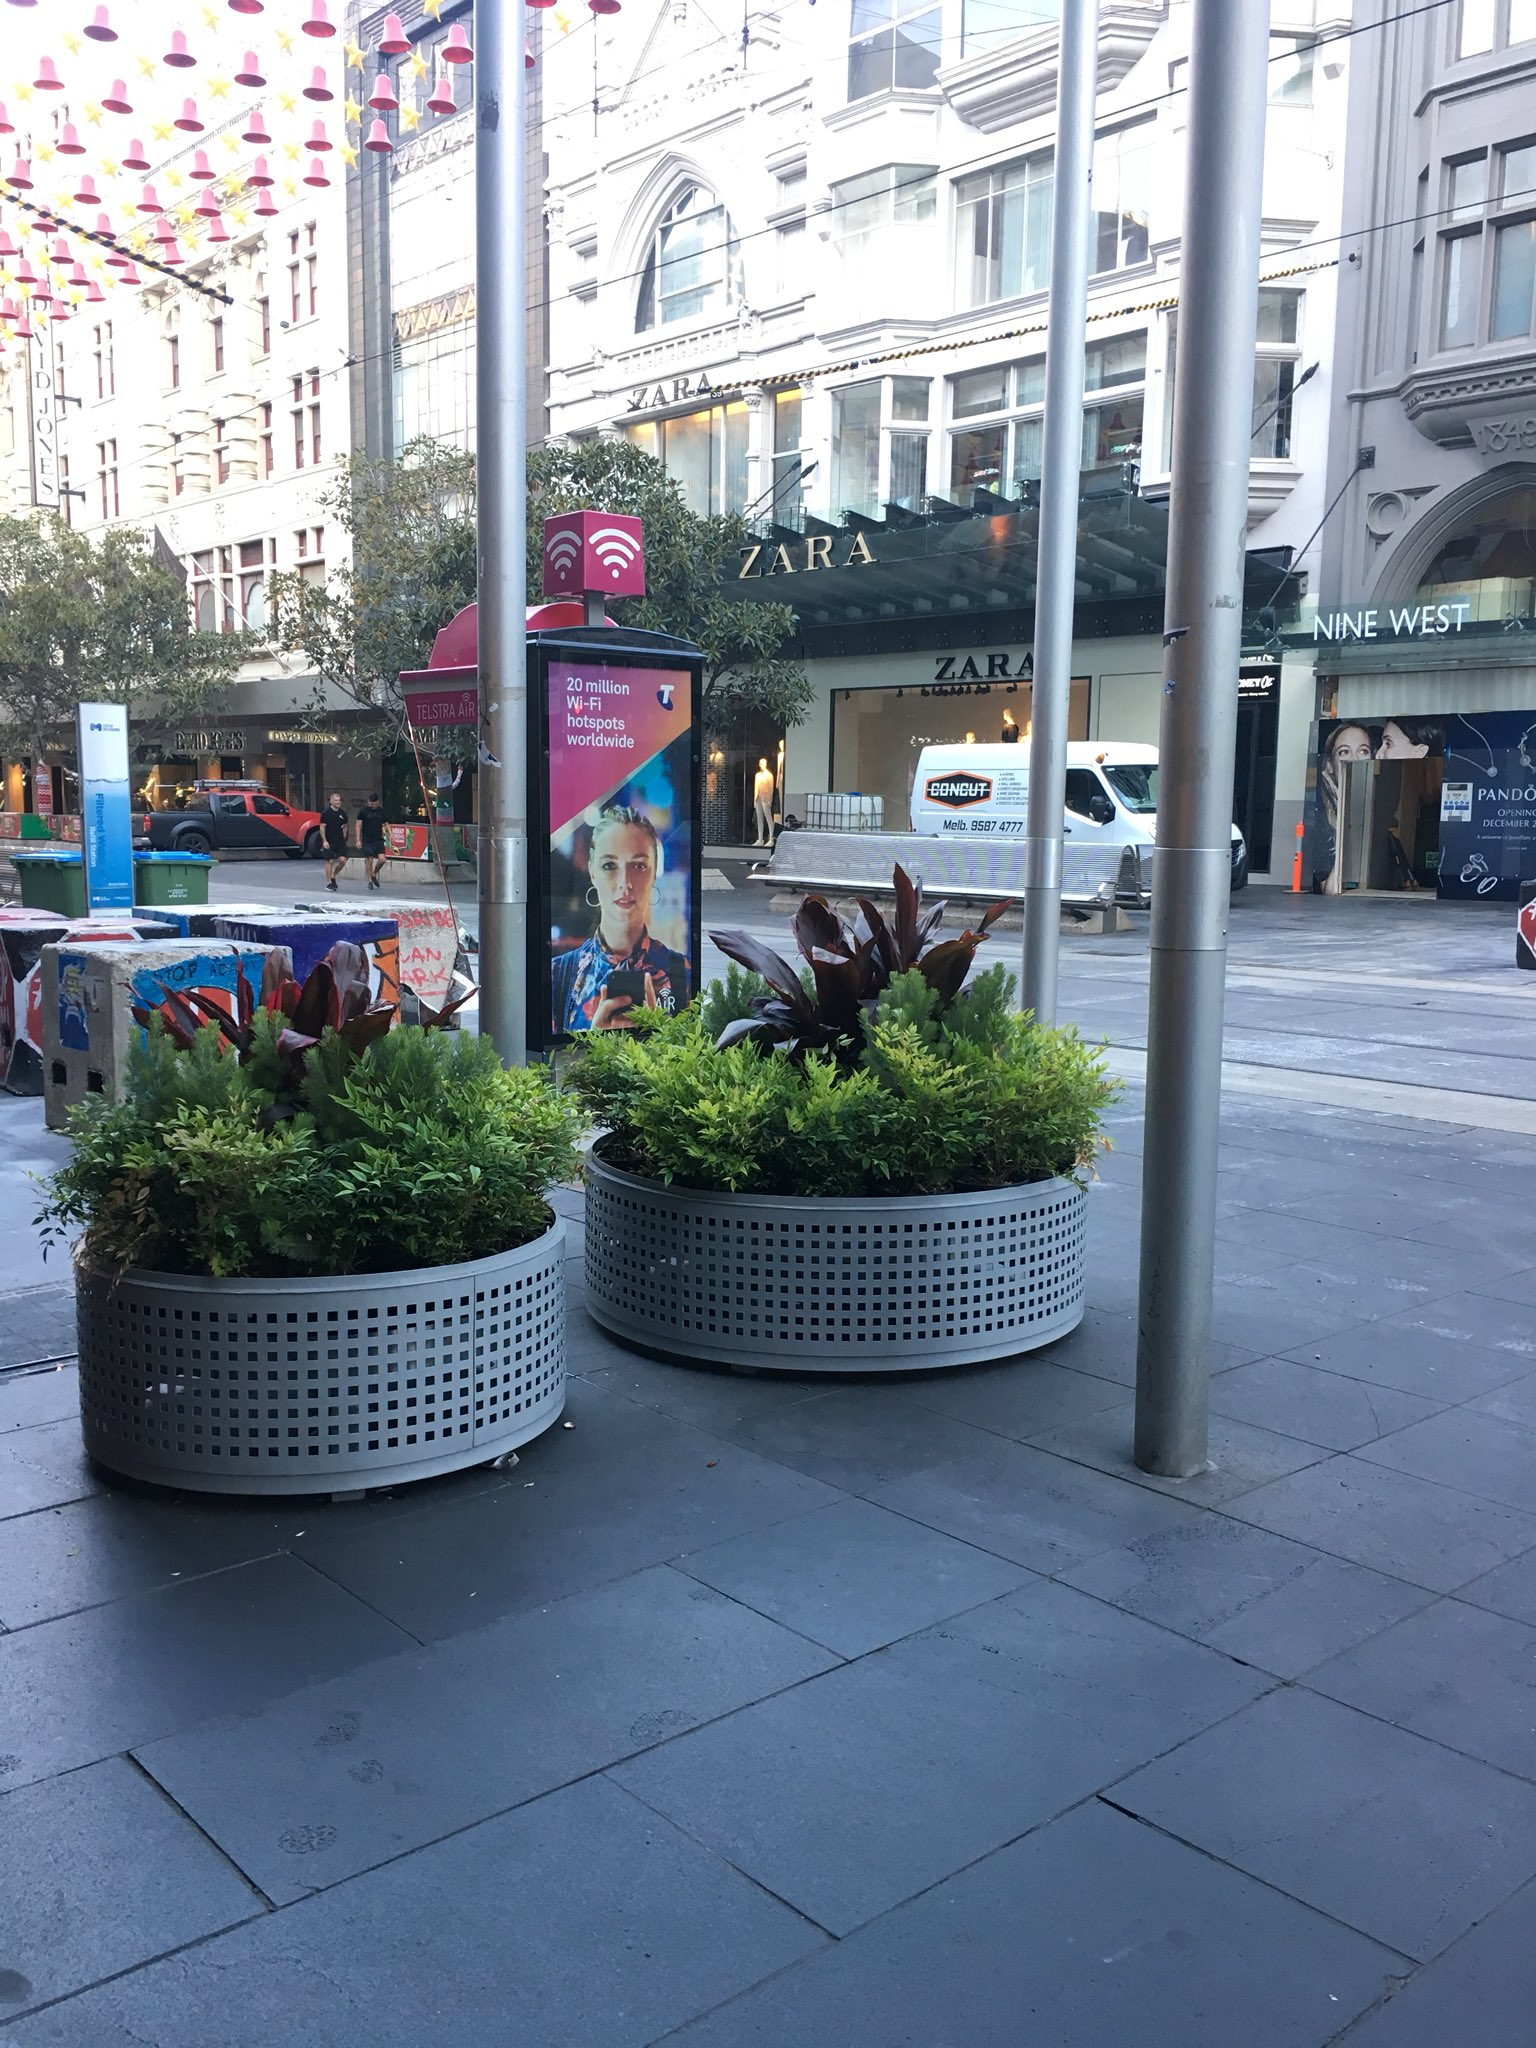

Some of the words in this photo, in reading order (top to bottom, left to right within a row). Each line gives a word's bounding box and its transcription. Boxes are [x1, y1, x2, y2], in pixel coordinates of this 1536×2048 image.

[632, 373, 711, 409] ZARA
[36, 398, 53, 496] JONES
[739, 530, 878, 579] ZARA
[1313, 610, 1378, 641] NINE
[1389, 603, 1470, 636] WEST
[935, 652, 1034, 680] ZARA
[567, 677, 583, 691] 20
[585, 680, 630, 695] million
[416, 703, 456, 720] TELSTRA
[567, 695, 602, 711] Wi-Fi
[567, 713, 625, 732] hotspots
[567, 733, 635, 748] worldwide
[930, 782, 988, 797] CONCUT
[96, 793, 106, 833] Filtered
[943, 819, 968, 831] Melb.
[971, 820, 997, 832] 9587
[999, 821, 1024, 833] 4777
[1483, 819, 1529, 828] DECEMBER
